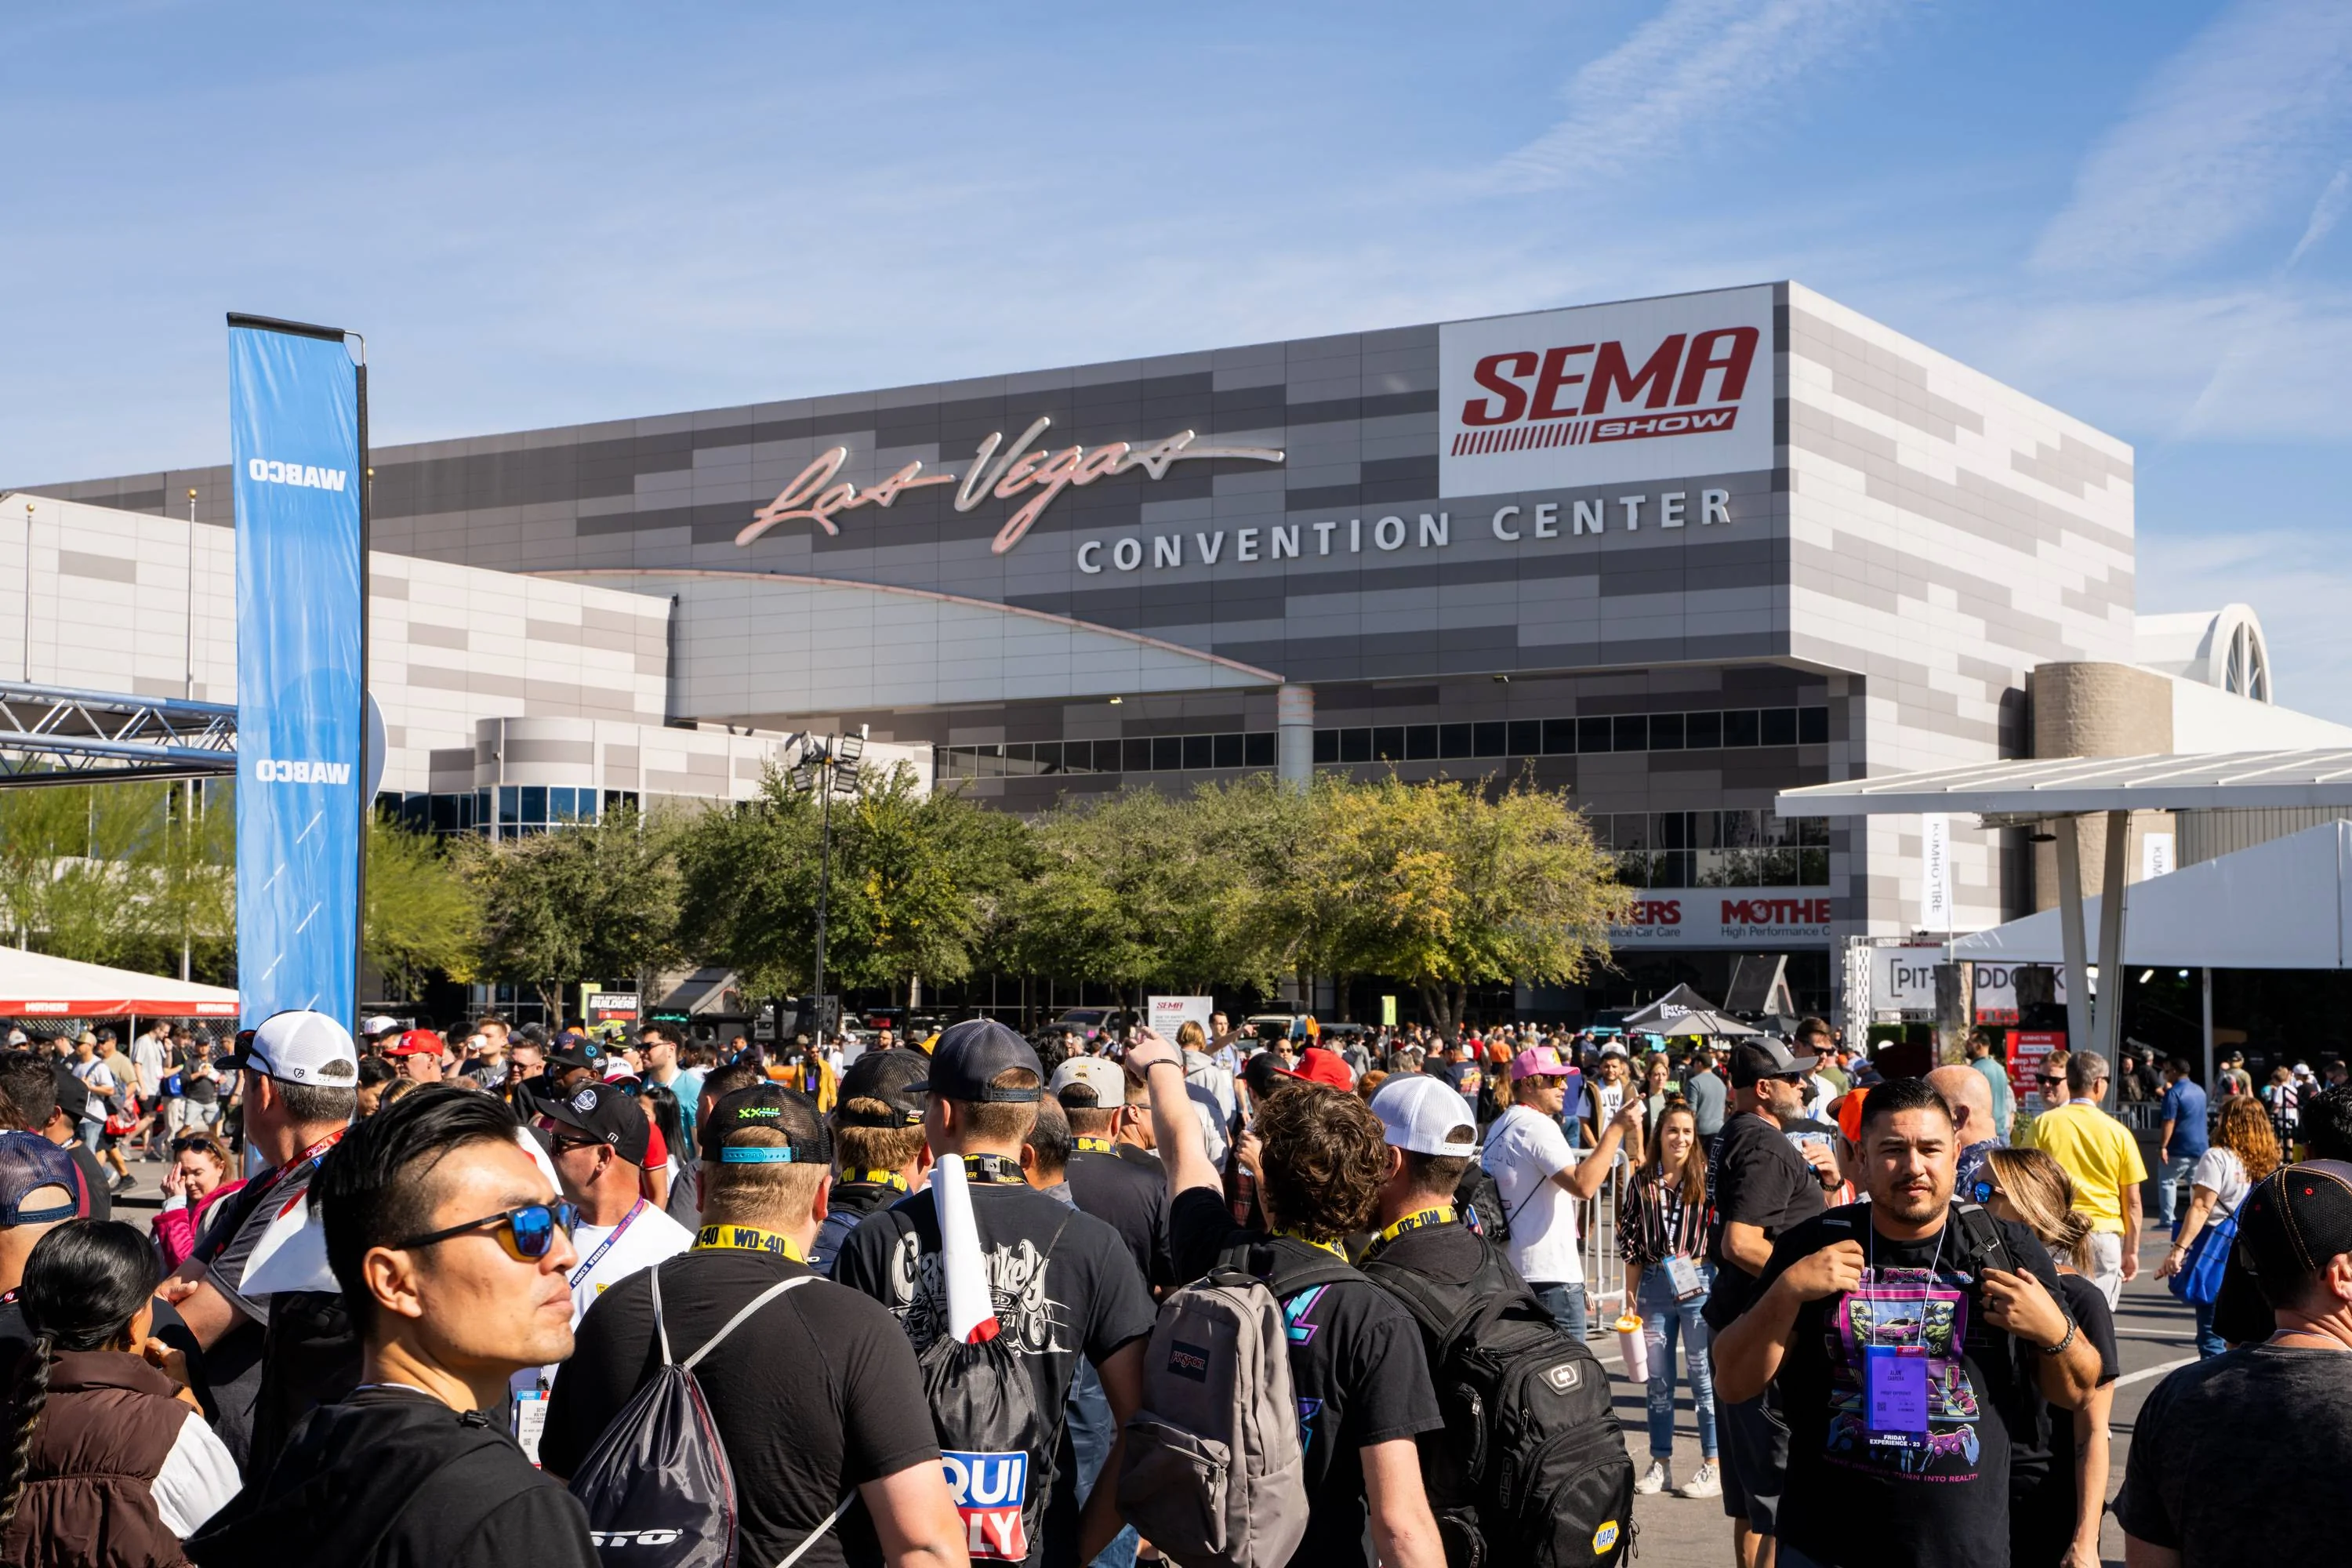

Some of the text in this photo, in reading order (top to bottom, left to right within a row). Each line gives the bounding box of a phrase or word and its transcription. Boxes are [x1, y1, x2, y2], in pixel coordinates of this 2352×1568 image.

[1461, 326, 1759, 426] SEMA
[1596, 411, 1733, 438] SHOW
[735, 416, 1286, 554] Las Vegas
[1078, 488, 1732, 573] CONVENTION CENTER
[1931, 823, 1942, 913] KUMHO TIRE
[2153, 847, 2162, 875] KUM
[1721, 898, 1830, 925] MOTHE
[1635, 927, 1656, 938] Car
[1657, 927, 1681, 938] Care
[1721, 926, 1746, 939] High
[1750, 925, 1819, 938] Performance
[25, 1002, 69, 1012] MOTHERS
[1078, 1138, 1110, 1152] WD-40
[866, 1168, 907, 1192] WD-40
[734, 1228, 786, 1254] WD-40
[572, 1265, 589, 1285] FORCE
[588, 1242, 609, 1265] WHEELS
[941, 1457, 1022, 1505] QUI
[1893, 1472, 1919, 1481] TURN
[1597, 1527, 1615, 1548] NAPA
